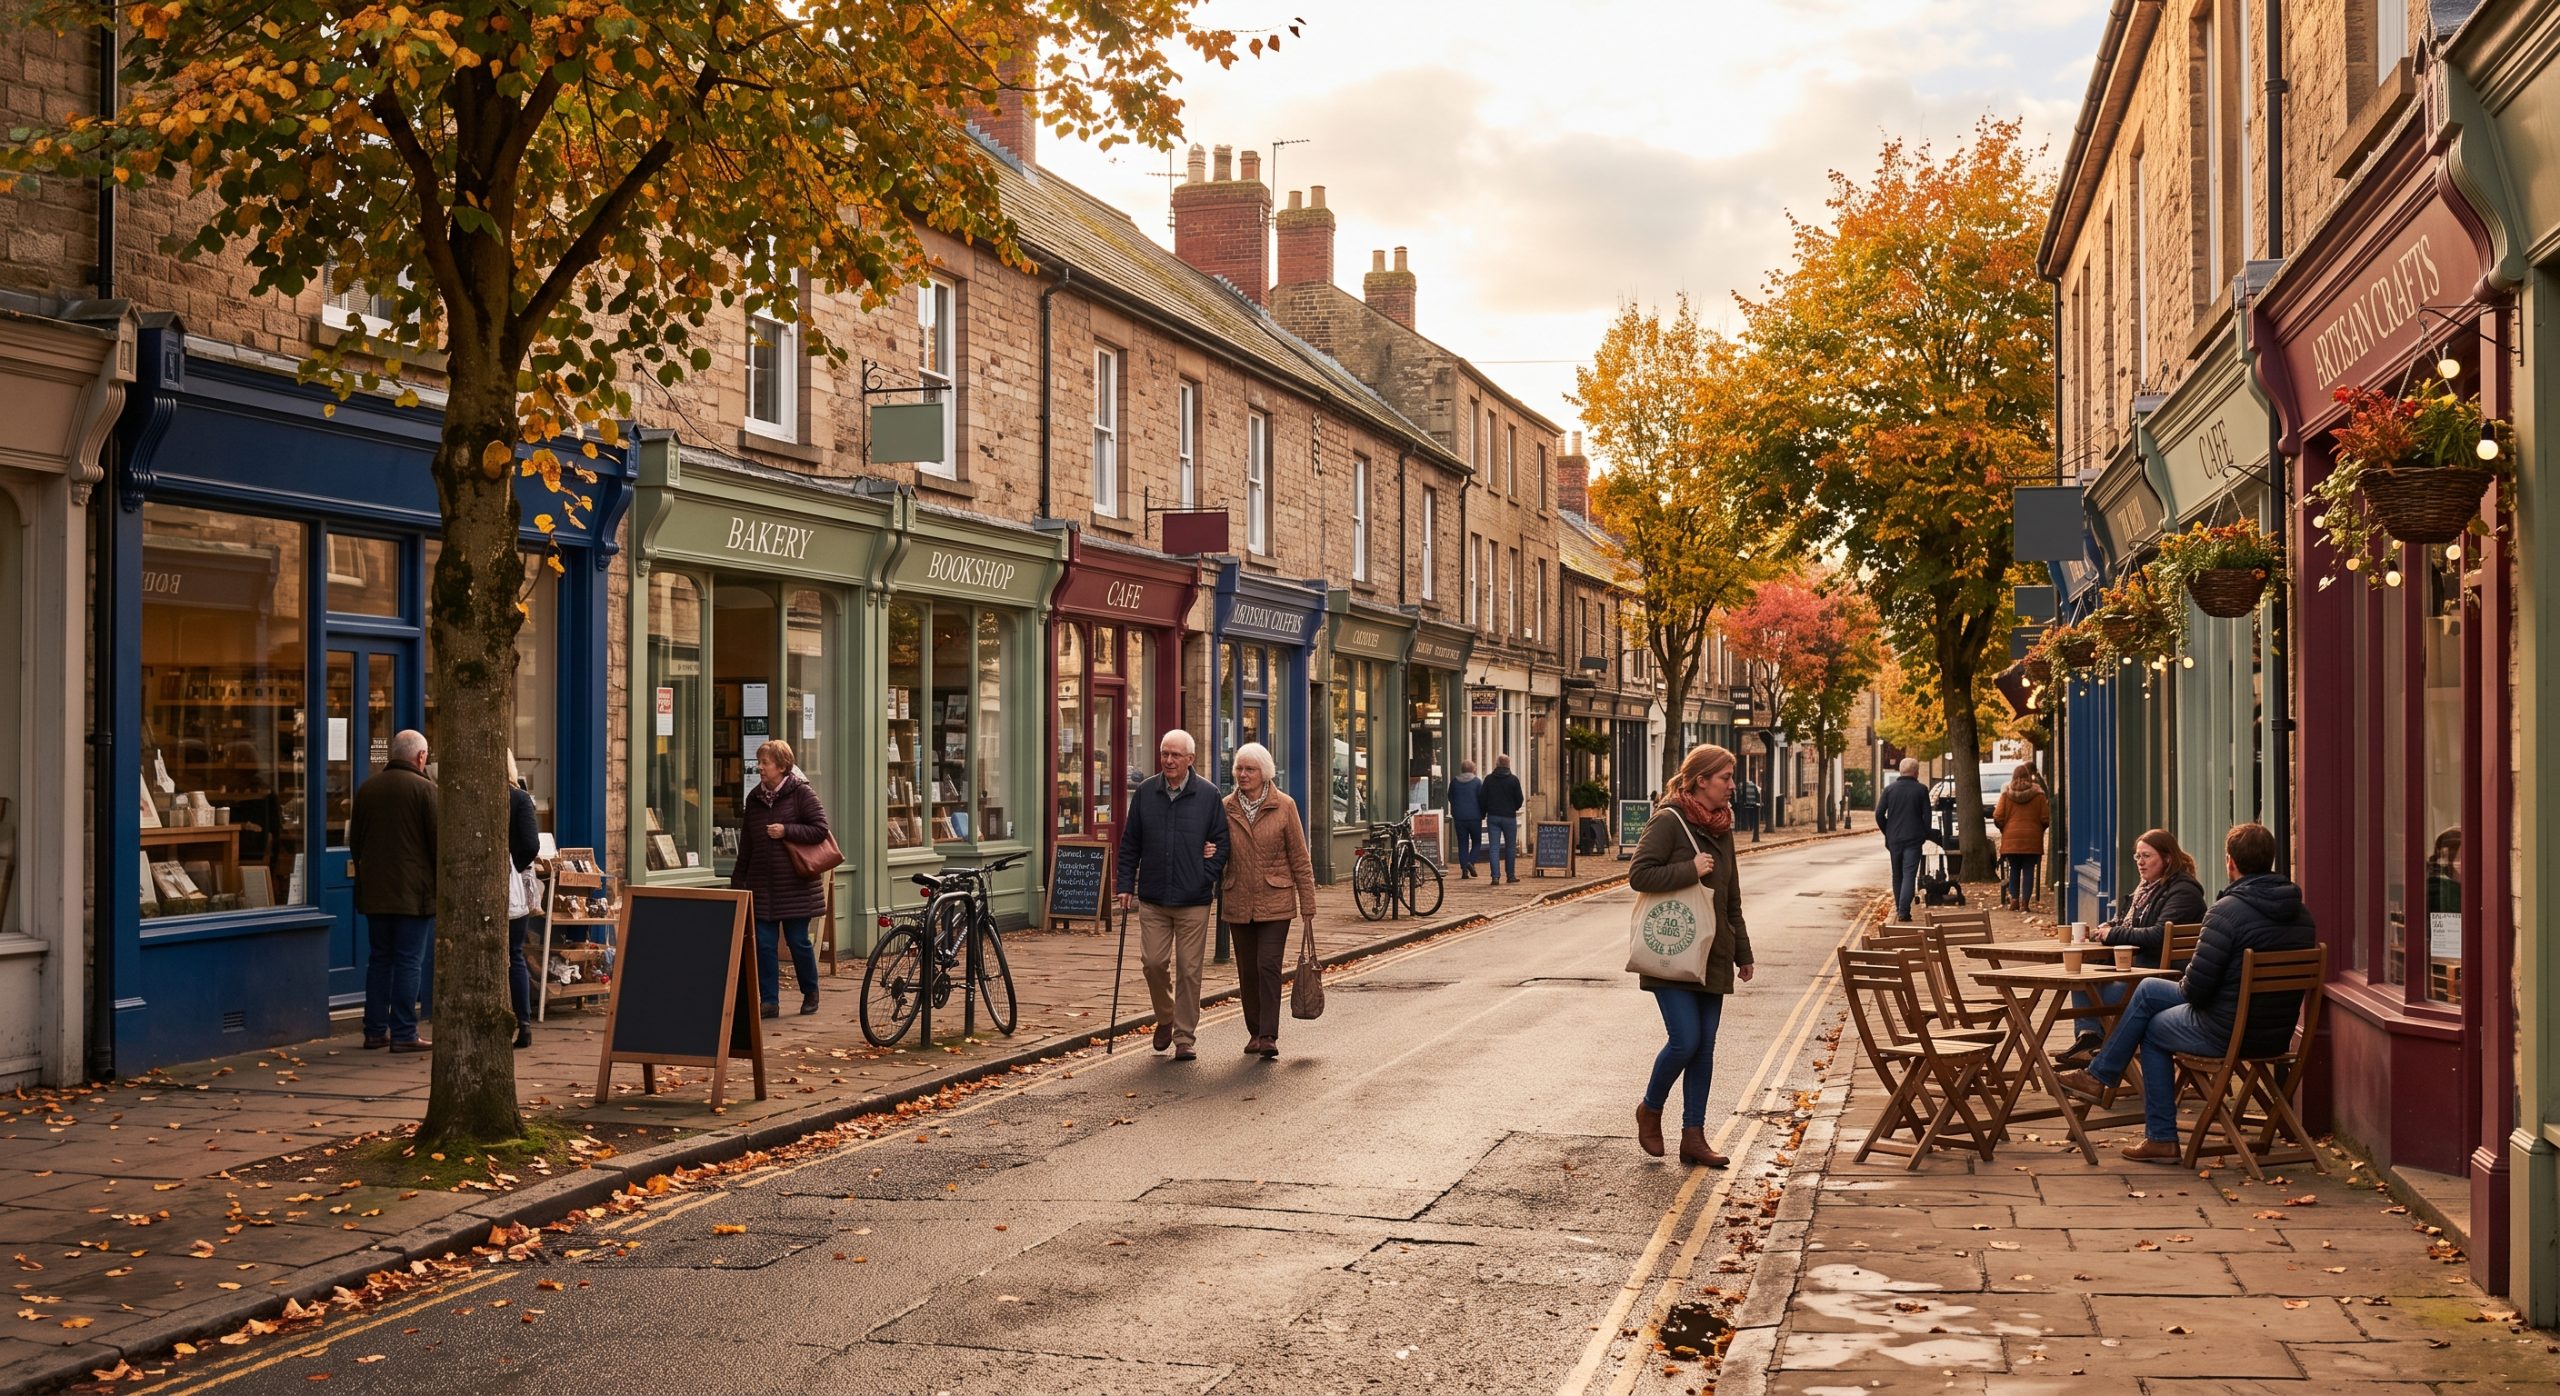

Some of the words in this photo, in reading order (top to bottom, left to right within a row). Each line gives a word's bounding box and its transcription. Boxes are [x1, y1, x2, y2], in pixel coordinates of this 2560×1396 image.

[2312, 294, 2376, 391] ARTISAN
[2370, 234, 2440, 339] CRAFTS
[725, 516, 815, 560] BAKERY
[927, 551, 1015, 590] BOOKSHOP
[1107, 580, 1144, 609] CAFE
